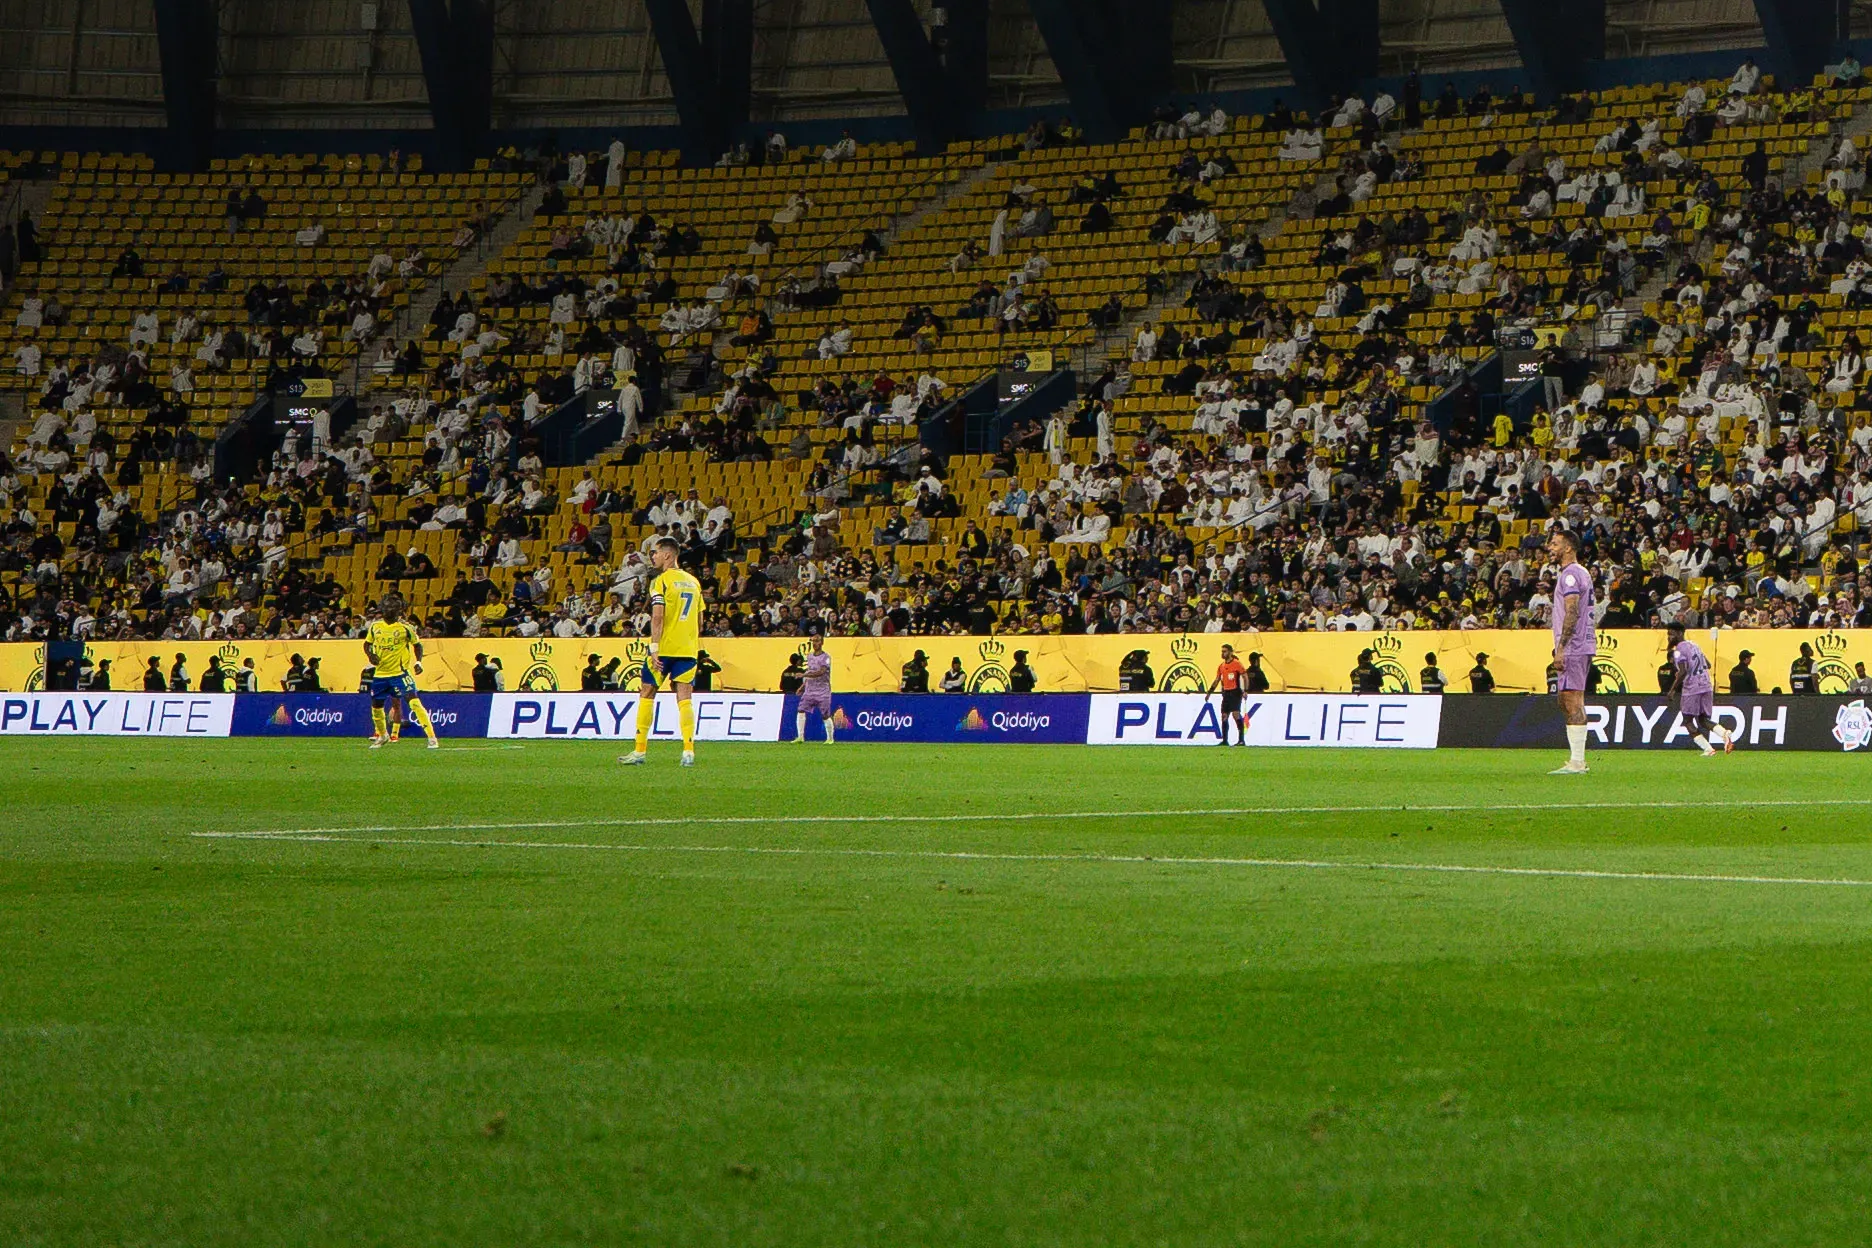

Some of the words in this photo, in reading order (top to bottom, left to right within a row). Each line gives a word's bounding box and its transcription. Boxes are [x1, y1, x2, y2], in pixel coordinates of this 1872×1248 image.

[1520, 335, 1535, 346] S16
[1014, 359, 1028, 369] S15
[1518, 362, 1538, 373] SMC
[289, 385, 303, 393] S13
[289, 408, 309, 417] SMC
[680, 591, 694, 620] 7
[402, 675, 413, 687] 10
[1, 699, 108, 731] PLAY
[121, 699, 212, 733] LIFE
[295, 708, 343, 726] Qiddiya
[510, 700, 636, 736] PLAY
[652, 700, 756, 737] LFE
[856, 711, 913, 731] Qiddiya
[991, 711, 1050, 732] Qiddiya
[1284, 703, 1408, 742] LIFE
[1847, 720, 1861, 730] RSL
